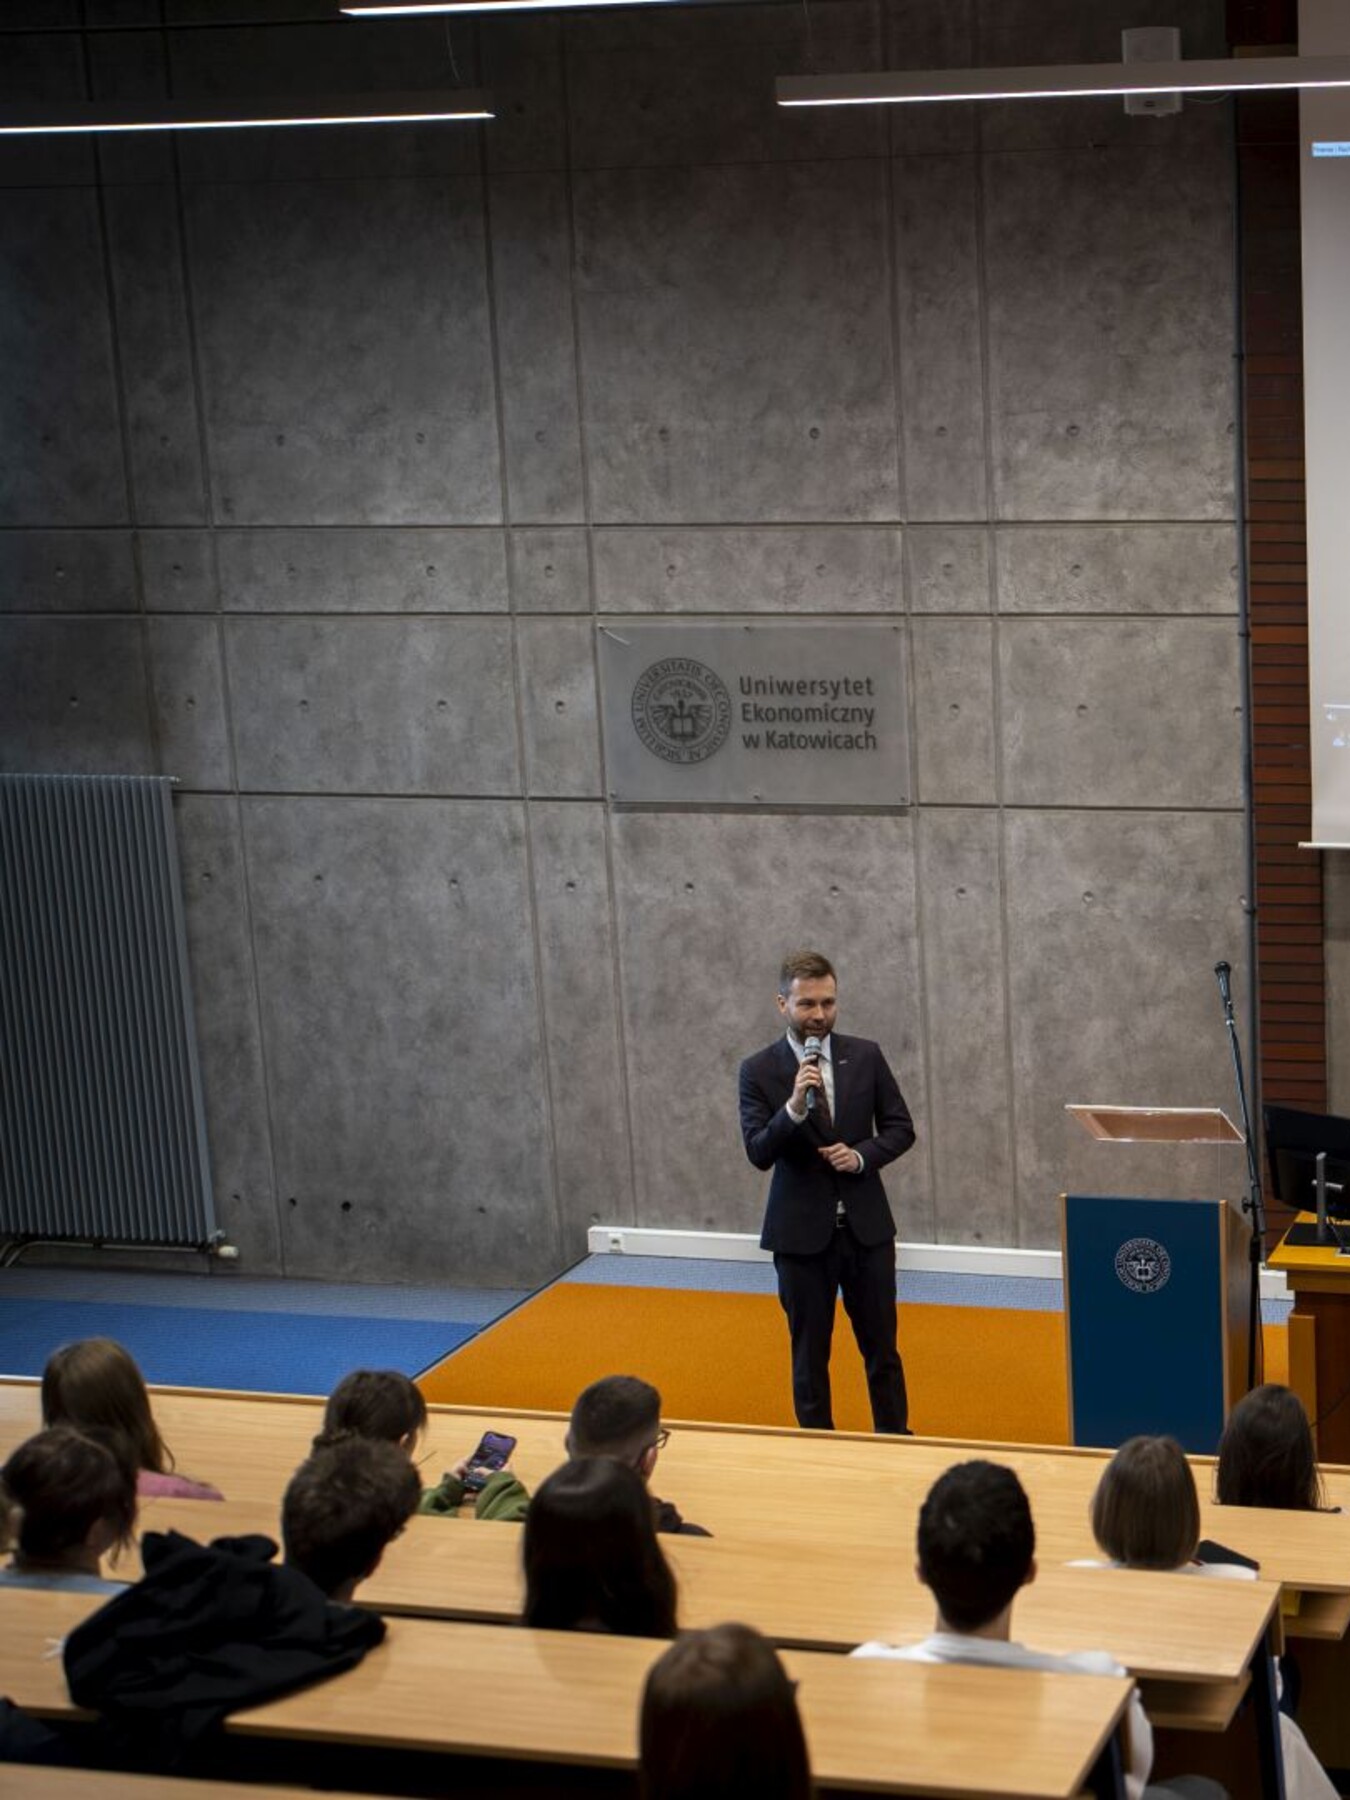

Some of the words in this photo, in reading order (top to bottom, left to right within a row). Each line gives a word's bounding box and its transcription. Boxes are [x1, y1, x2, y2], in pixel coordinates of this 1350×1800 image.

[739, 676, 874, 700] Uniwersytet
[741, 703, 875, 727] Ekonomiczny
[743, 734, 760, 749] w
[766, 731, 877, 750] Katowicach
